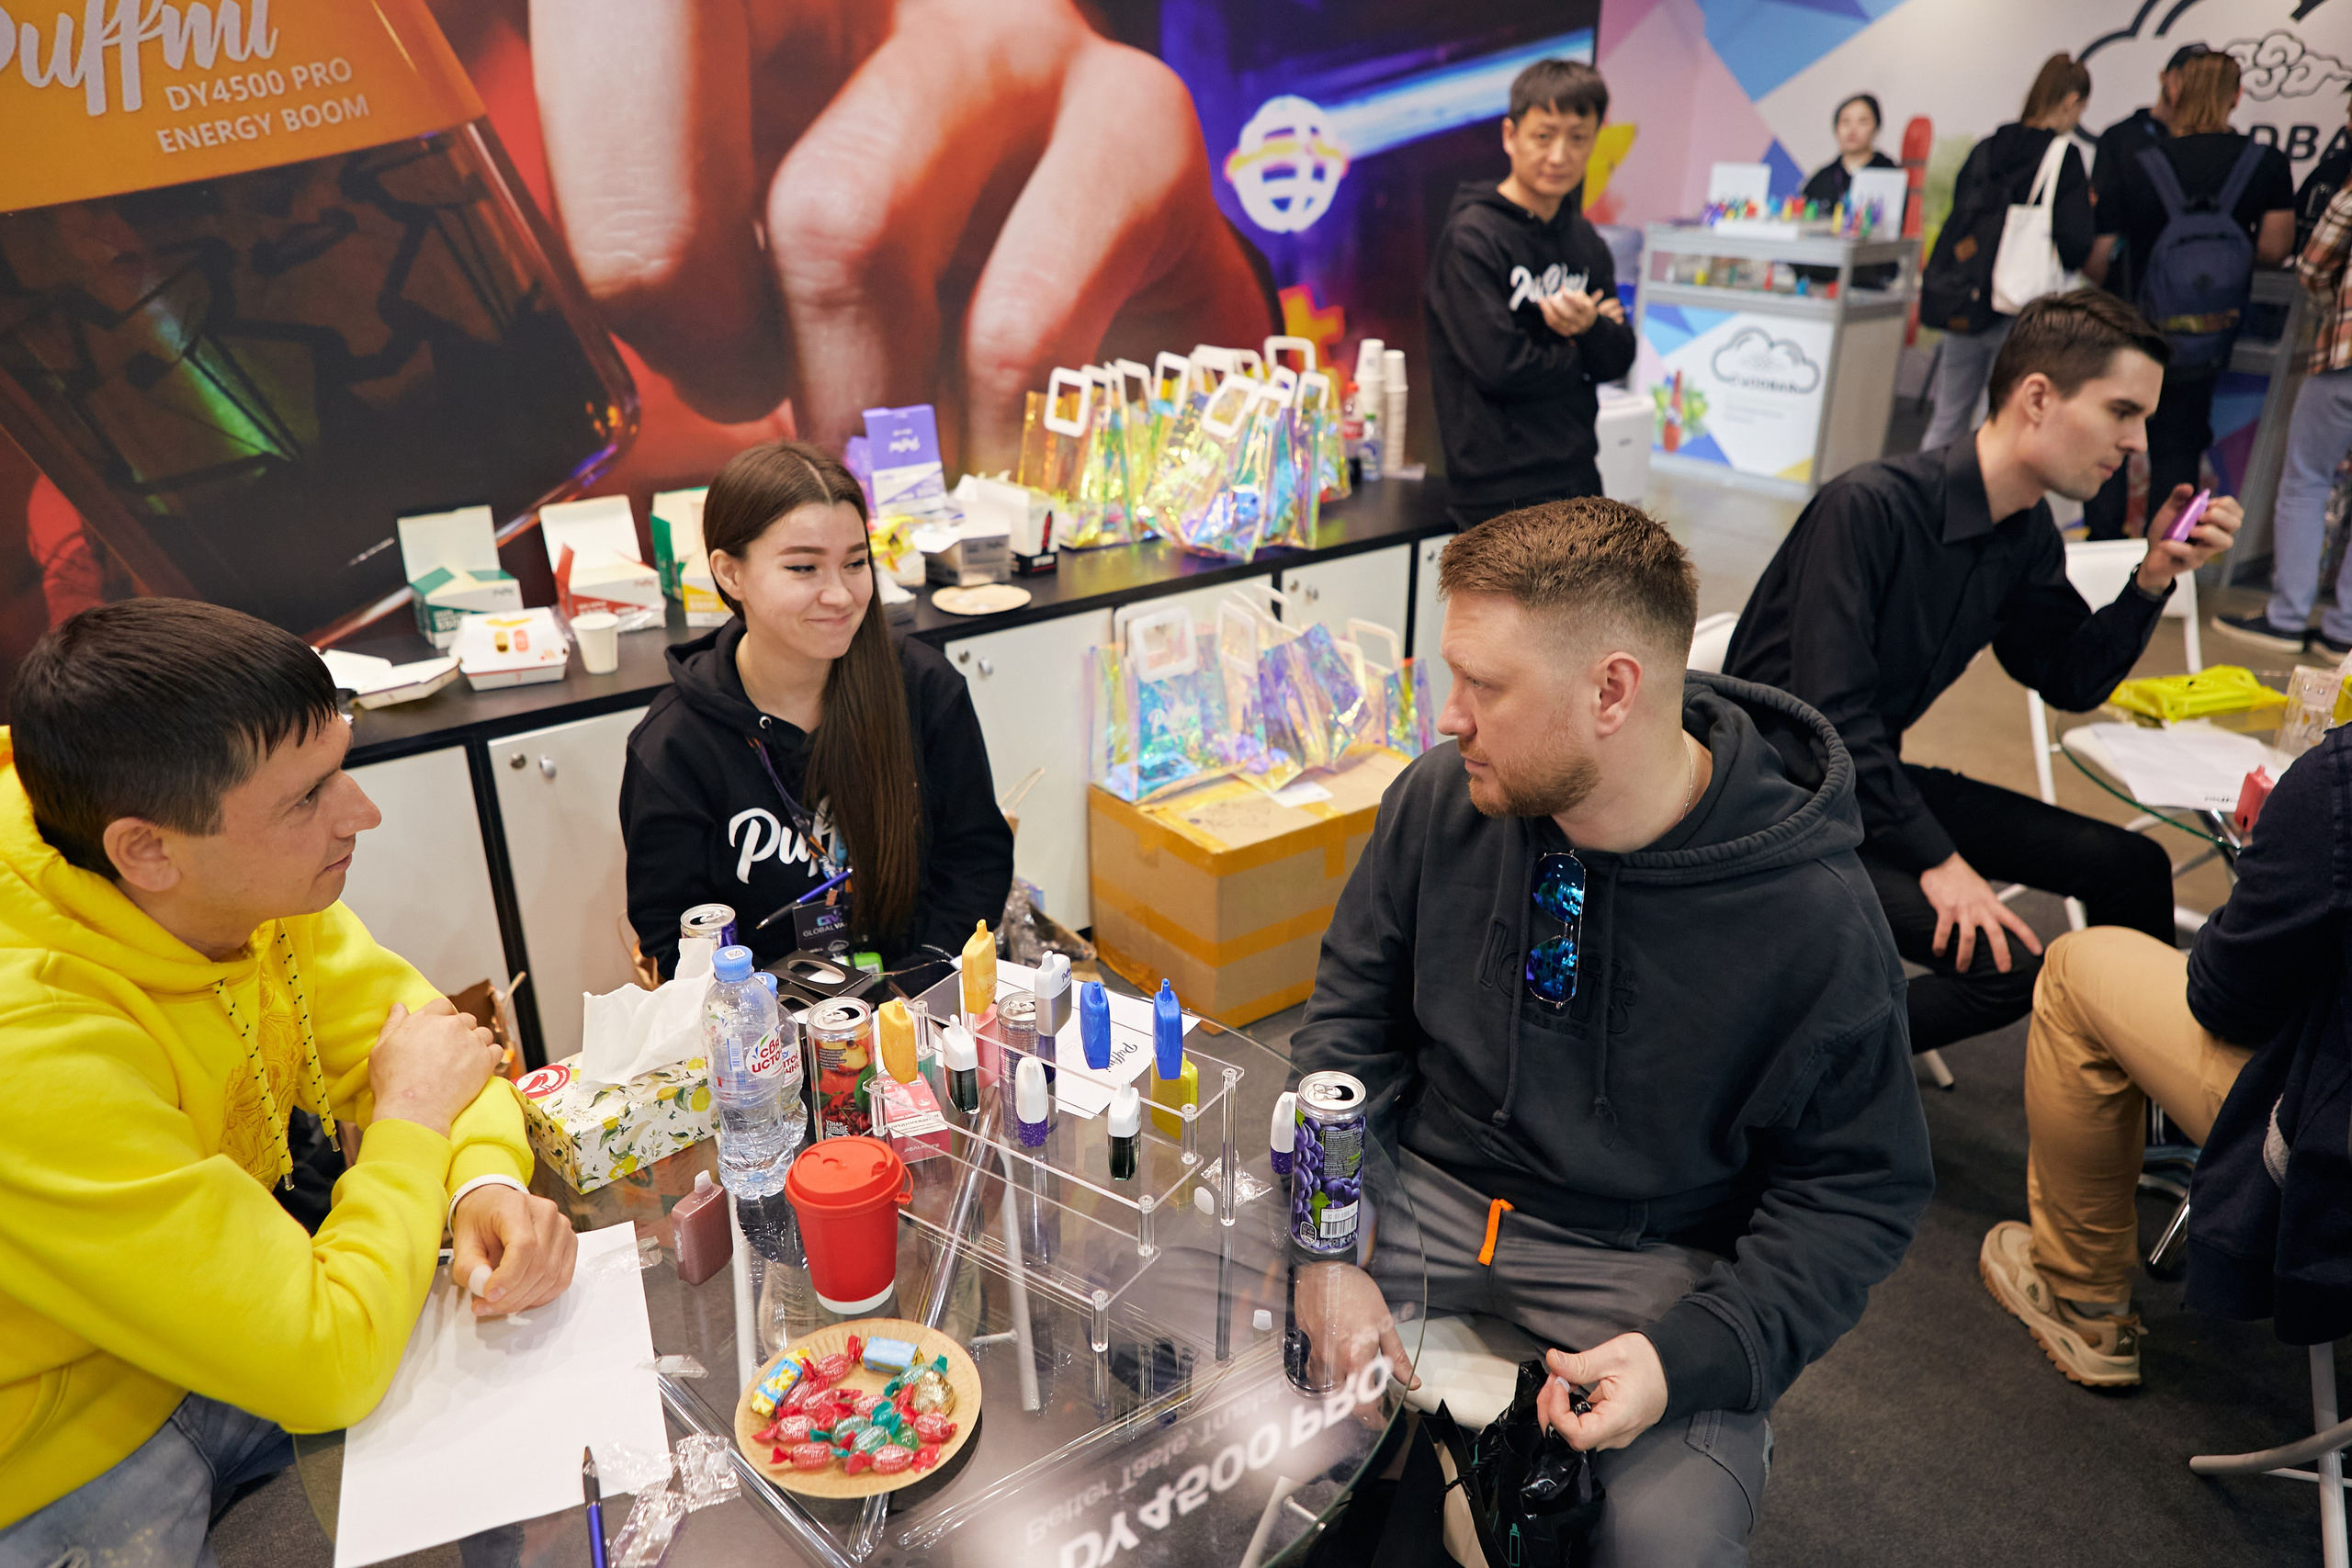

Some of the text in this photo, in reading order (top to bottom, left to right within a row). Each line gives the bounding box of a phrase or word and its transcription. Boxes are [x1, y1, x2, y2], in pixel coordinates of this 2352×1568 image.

[0, 0, 278, 116] uffmi
[164, 57, 353, 112] DY4500 PRO
[155, 94, 369, 154] ENERGY BOOM
